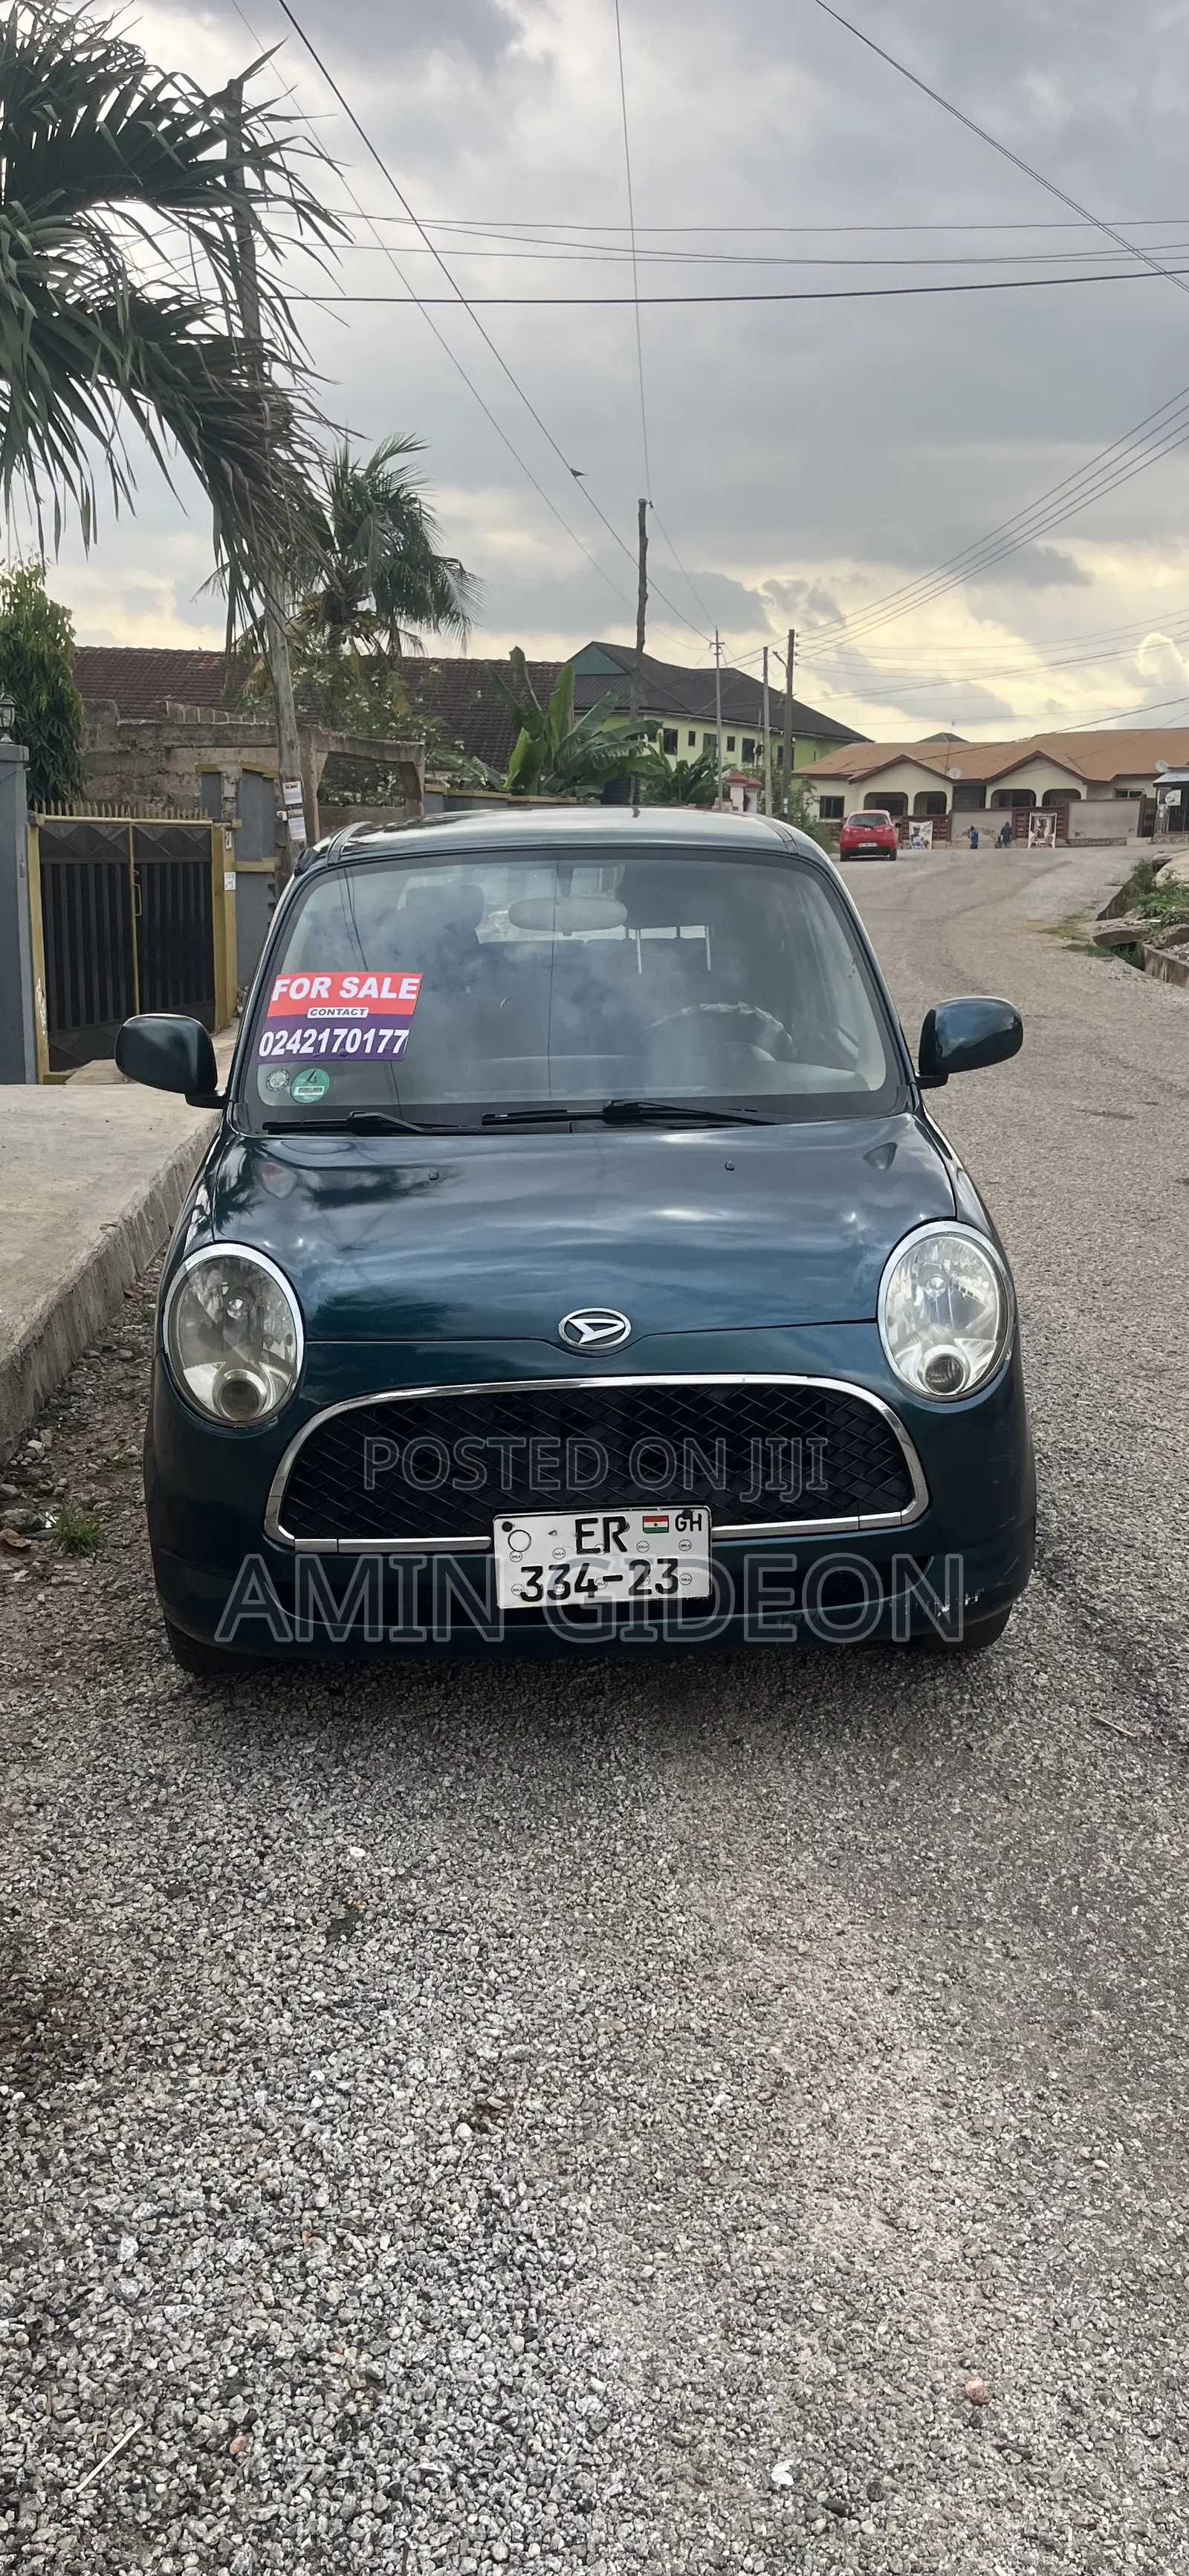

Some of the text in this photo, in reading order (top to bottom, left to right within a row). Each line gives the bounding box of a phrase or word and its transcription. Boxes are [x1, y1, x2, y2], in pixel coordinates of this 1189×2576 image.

[271, 977, 420, 1001] FOR SALE
[310, 1008, 367, 1016] CONTACT
[259, 1028, 409, 1056] 0242170177
[574, 1513, 702, 1554] ER GH
[519, 1557, 678, 1602] 334-23
